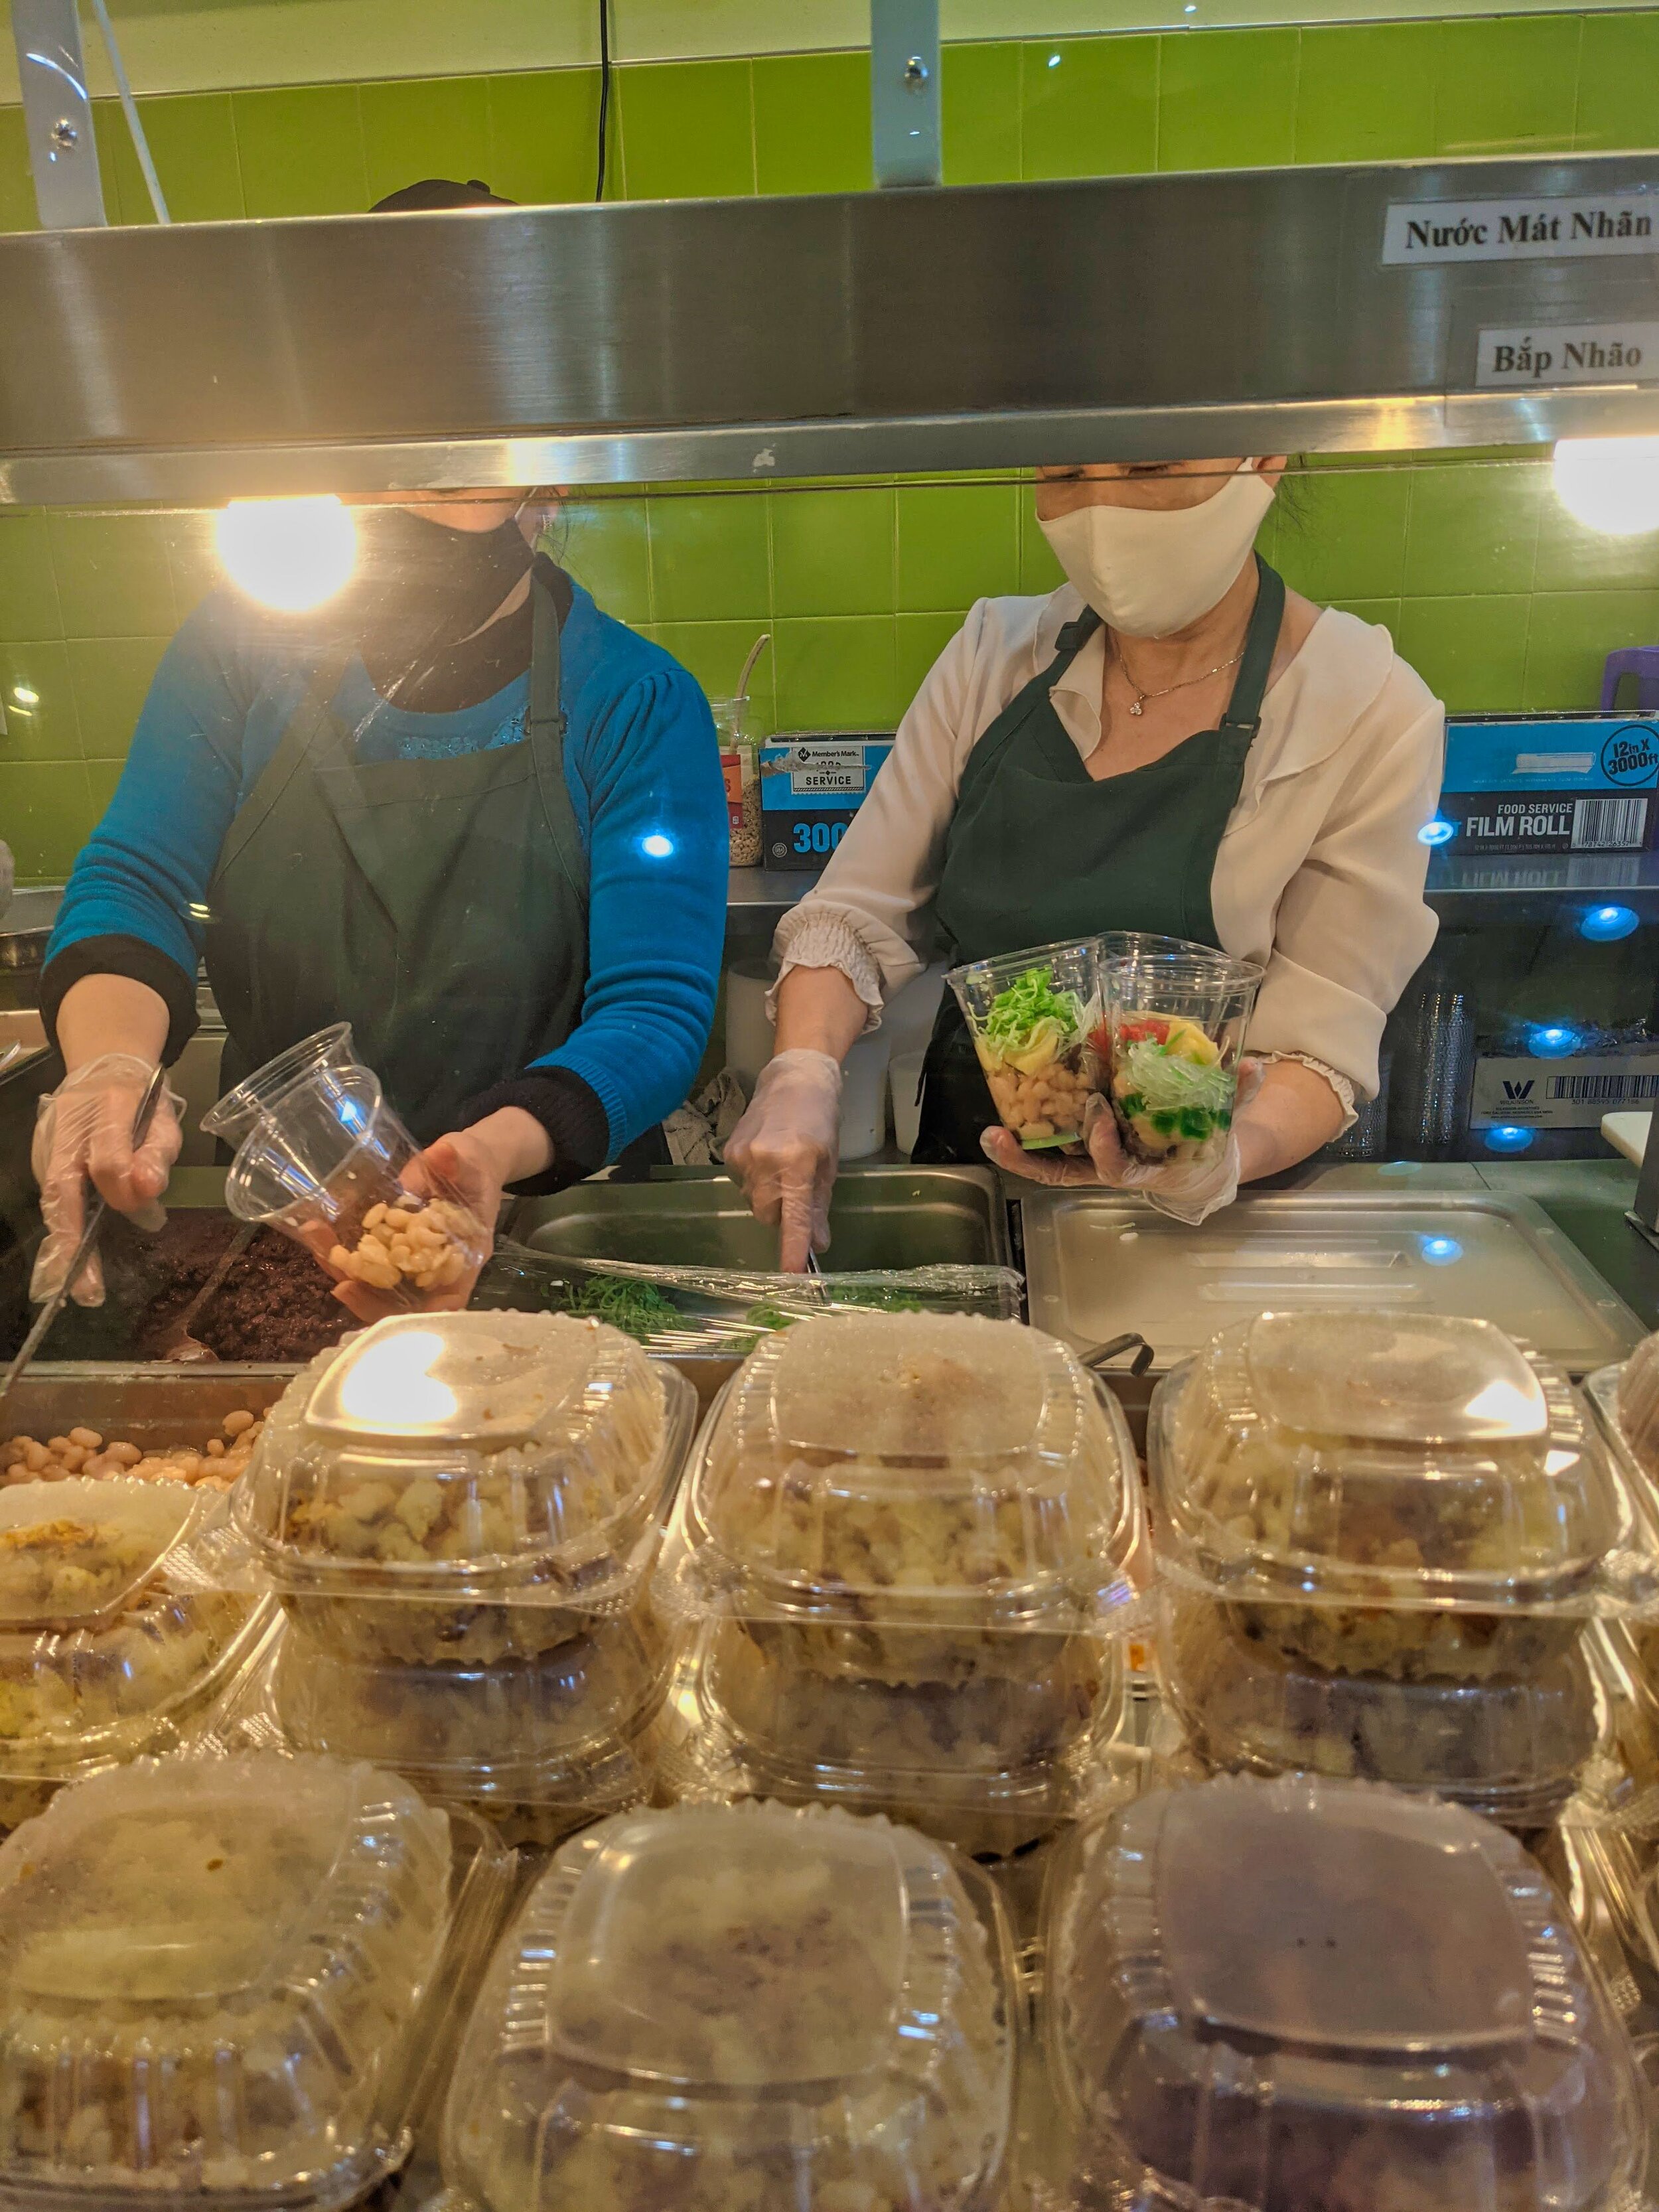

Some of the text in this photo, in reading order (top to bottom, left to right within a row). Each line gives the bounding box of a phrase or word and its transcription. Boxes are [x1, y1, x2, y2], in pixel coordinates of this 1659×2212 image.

[1406, 210, 1652, 249] Nước Mát Nhãn
[1492, 336, 1642, 378] Bắp Nhão
[1613, 741, 1639, 758] 12in
[1608, 752, 1658, 775] 3000ft
[806, 776, 851, 785] SERVICE
[1498, 803, 1573, 814] FOOD SERVICE
[1466, 816, 1515, 837] FILM
[1519, 815, 1570, 836] ROLL
